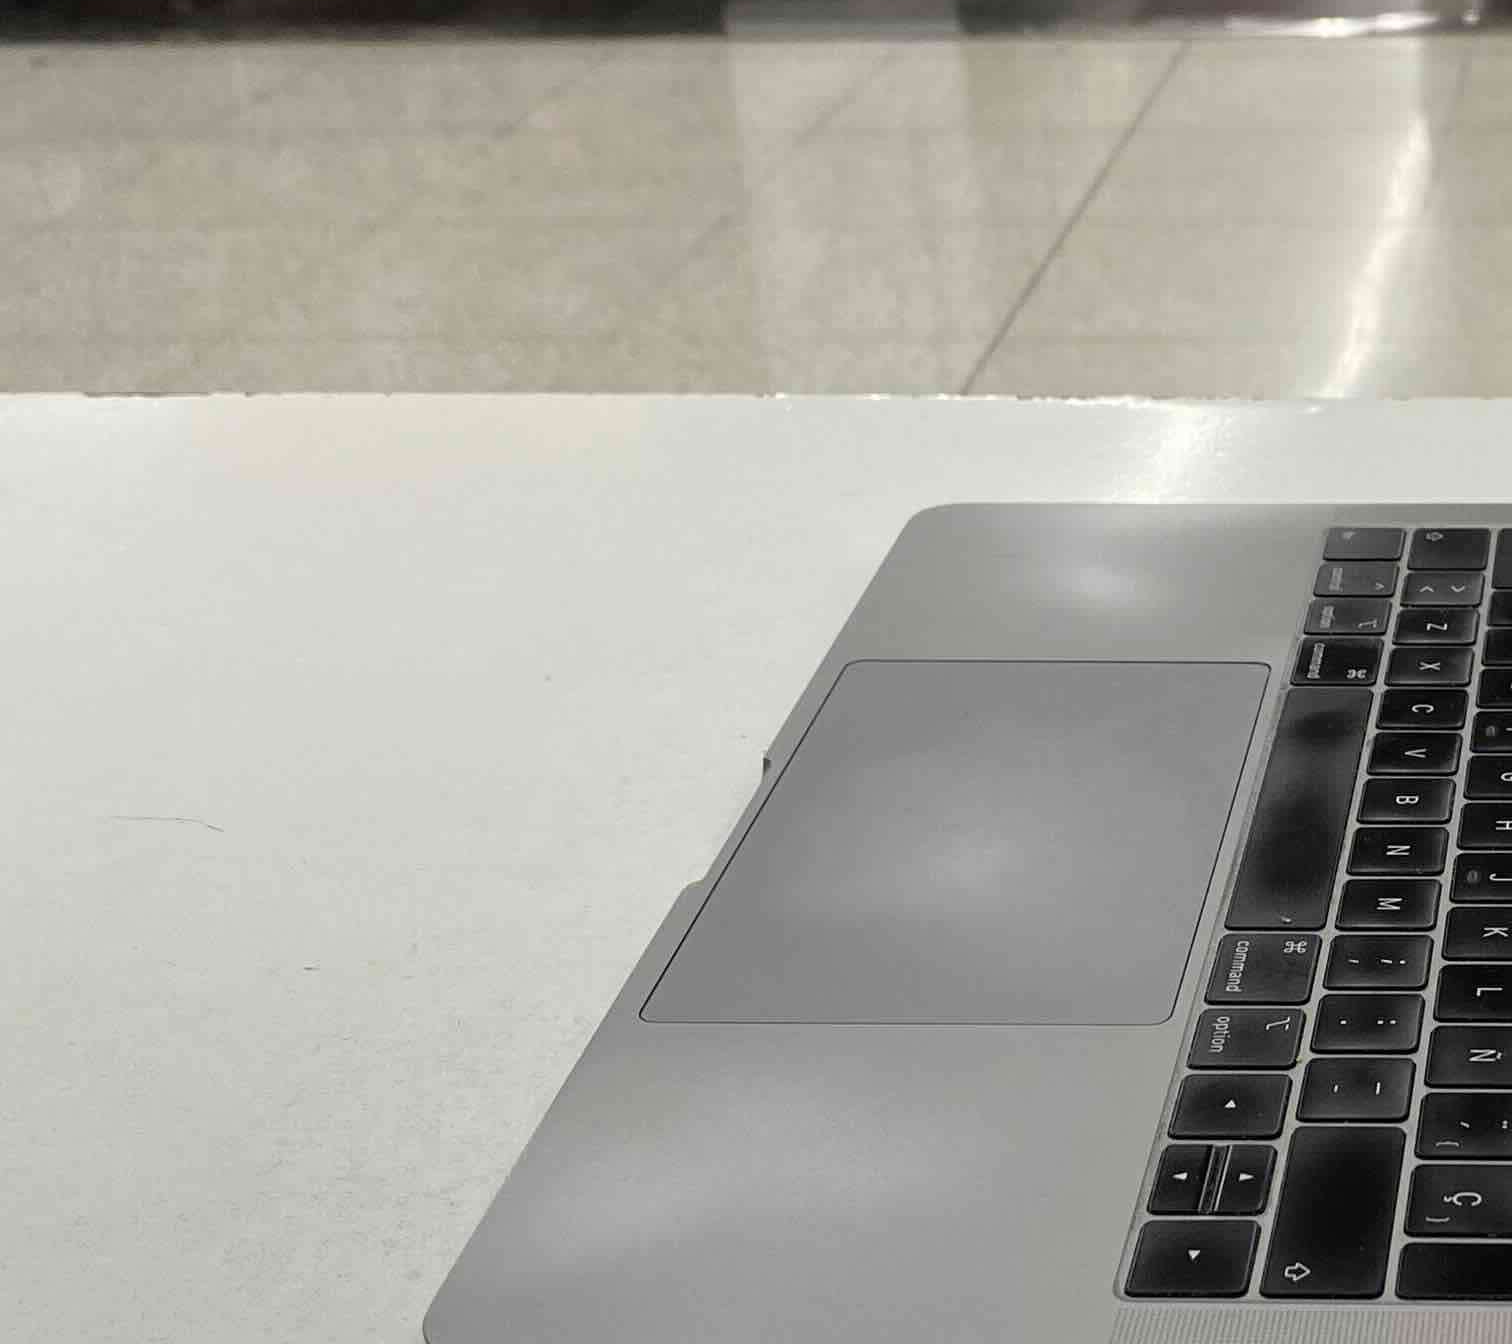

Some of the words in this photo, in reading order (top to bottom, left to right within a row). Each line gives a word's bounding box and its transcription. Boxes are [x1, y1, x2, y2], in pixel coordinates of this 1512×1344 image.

[1426, 623, 1448, 631] Z
[1419, 662, 1441, 670] X
[1405, 749, 1426, 757] V
[1396, 796, 1418, 804] B
[1387, 846, 1410, 855] N
[1377, 898, 1402, 909] M
[1484, 928, 1508, 937] K
[1225, 940, 1250, 993] command
[1477, 988, 1502, 996] L
[1210, 1016, 1231, 1054] option
[1470, 1050, 1501, 1061] Ñ
[1444, 1192, 1481, 1205] Ç
